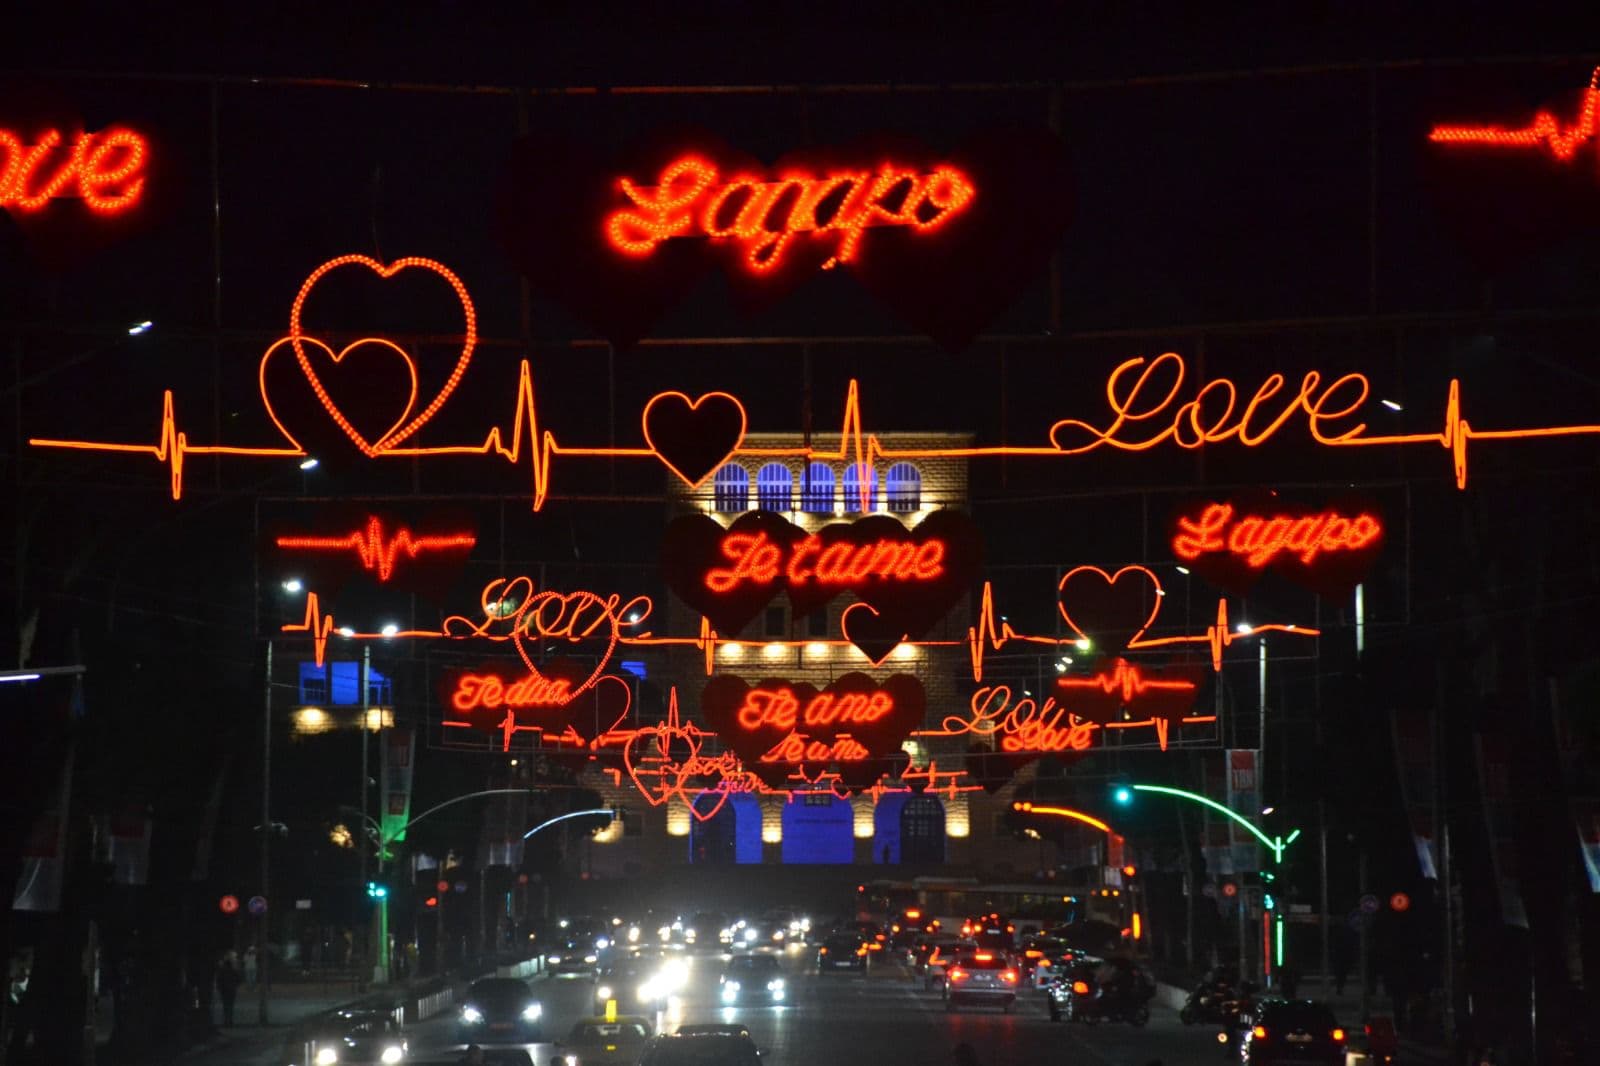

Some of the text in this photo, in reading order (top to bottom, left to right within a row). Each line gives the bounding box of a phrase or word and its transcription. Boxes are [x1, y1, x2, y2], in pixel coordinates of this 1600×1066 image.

[1050, 351, 1370, 451] Love
[704, 530, 783, 594] Je
[443, 576, 653, 643] Love
